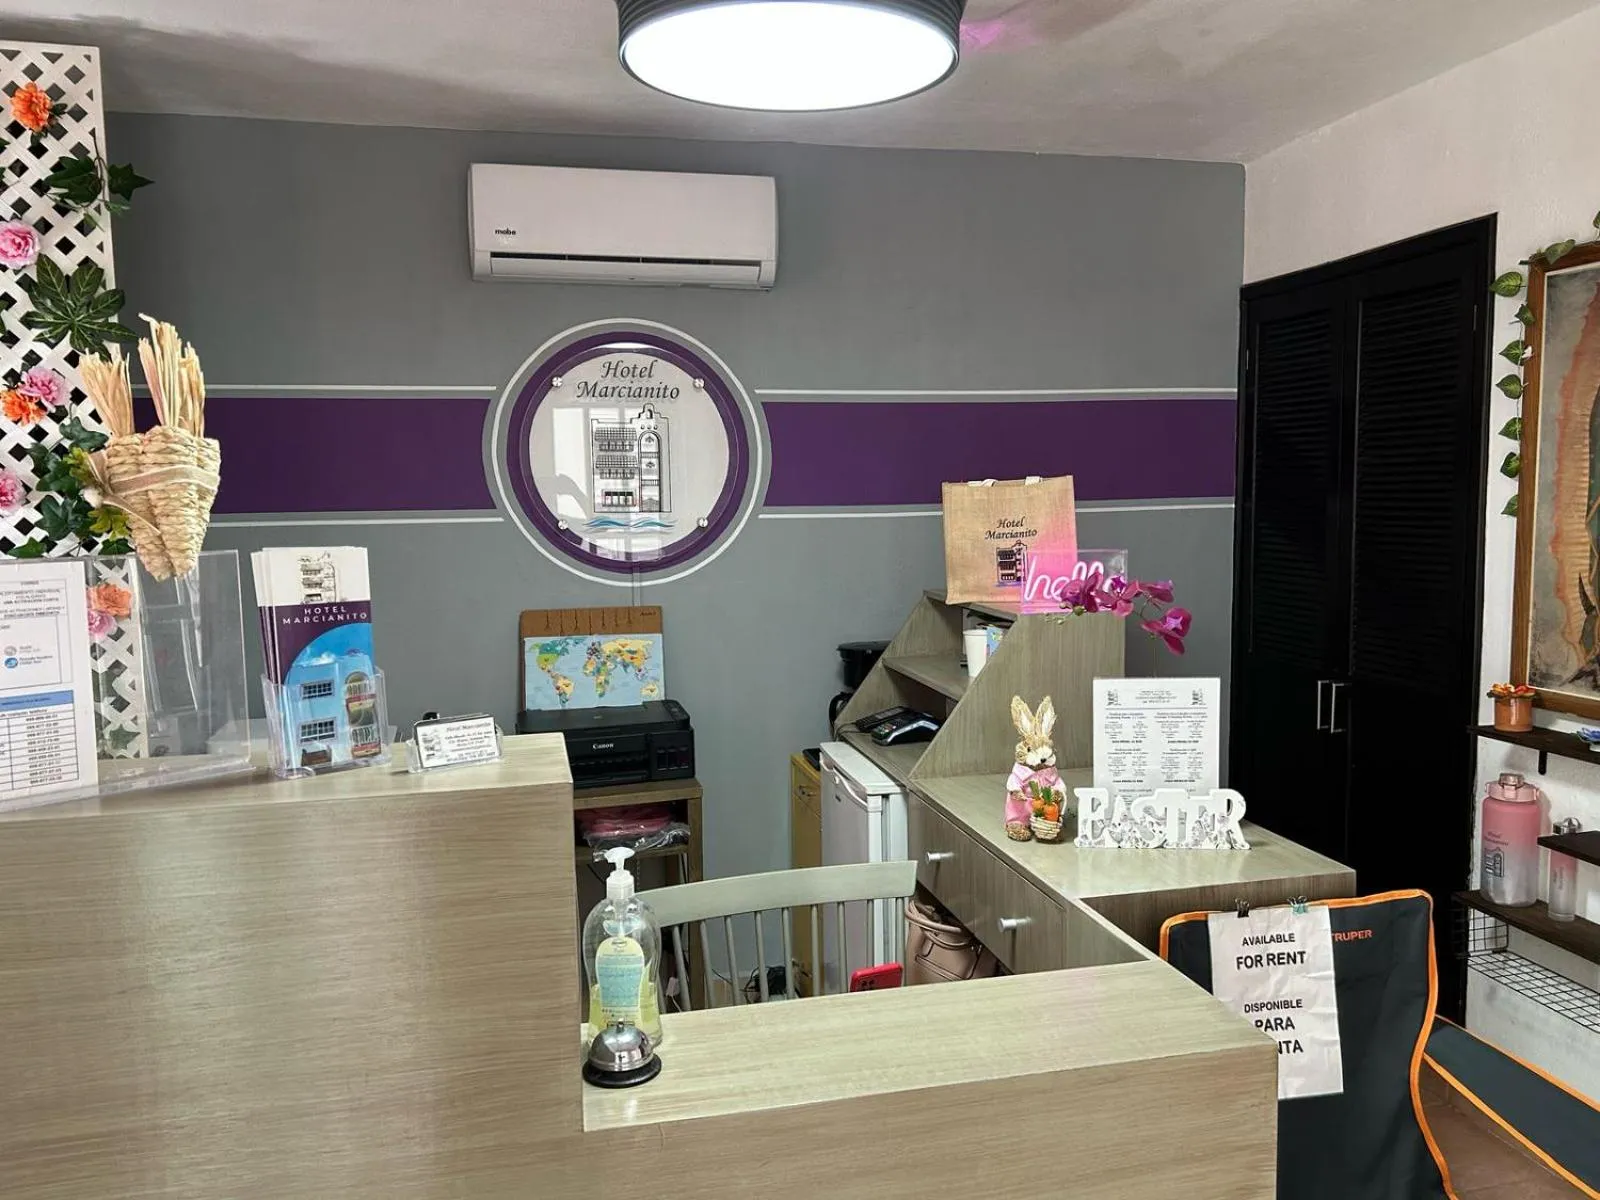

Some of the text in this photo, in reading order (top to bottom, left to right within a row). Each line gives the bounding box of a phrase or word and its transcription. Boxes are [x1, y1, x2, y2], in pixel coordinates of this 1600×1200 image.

[601, 360, 657, 380] Hotel
[576, 381, 680, 400] Marcianito
[997, 517, 1025, 530] Hotel
[985, 529, 1037, 540] Marcianito
[304, 605, 346, 614] HOTEL
[282, 613, 368, 625] MARCIANITO
[1242, 933, 1296, 946] AVAILABLE
[1236, 951, 1306, 971] FOR RENT
[1244, 999, 1303, 1013] DISPONIBLE
[1255, 1017, 1295, 1032] PARA
